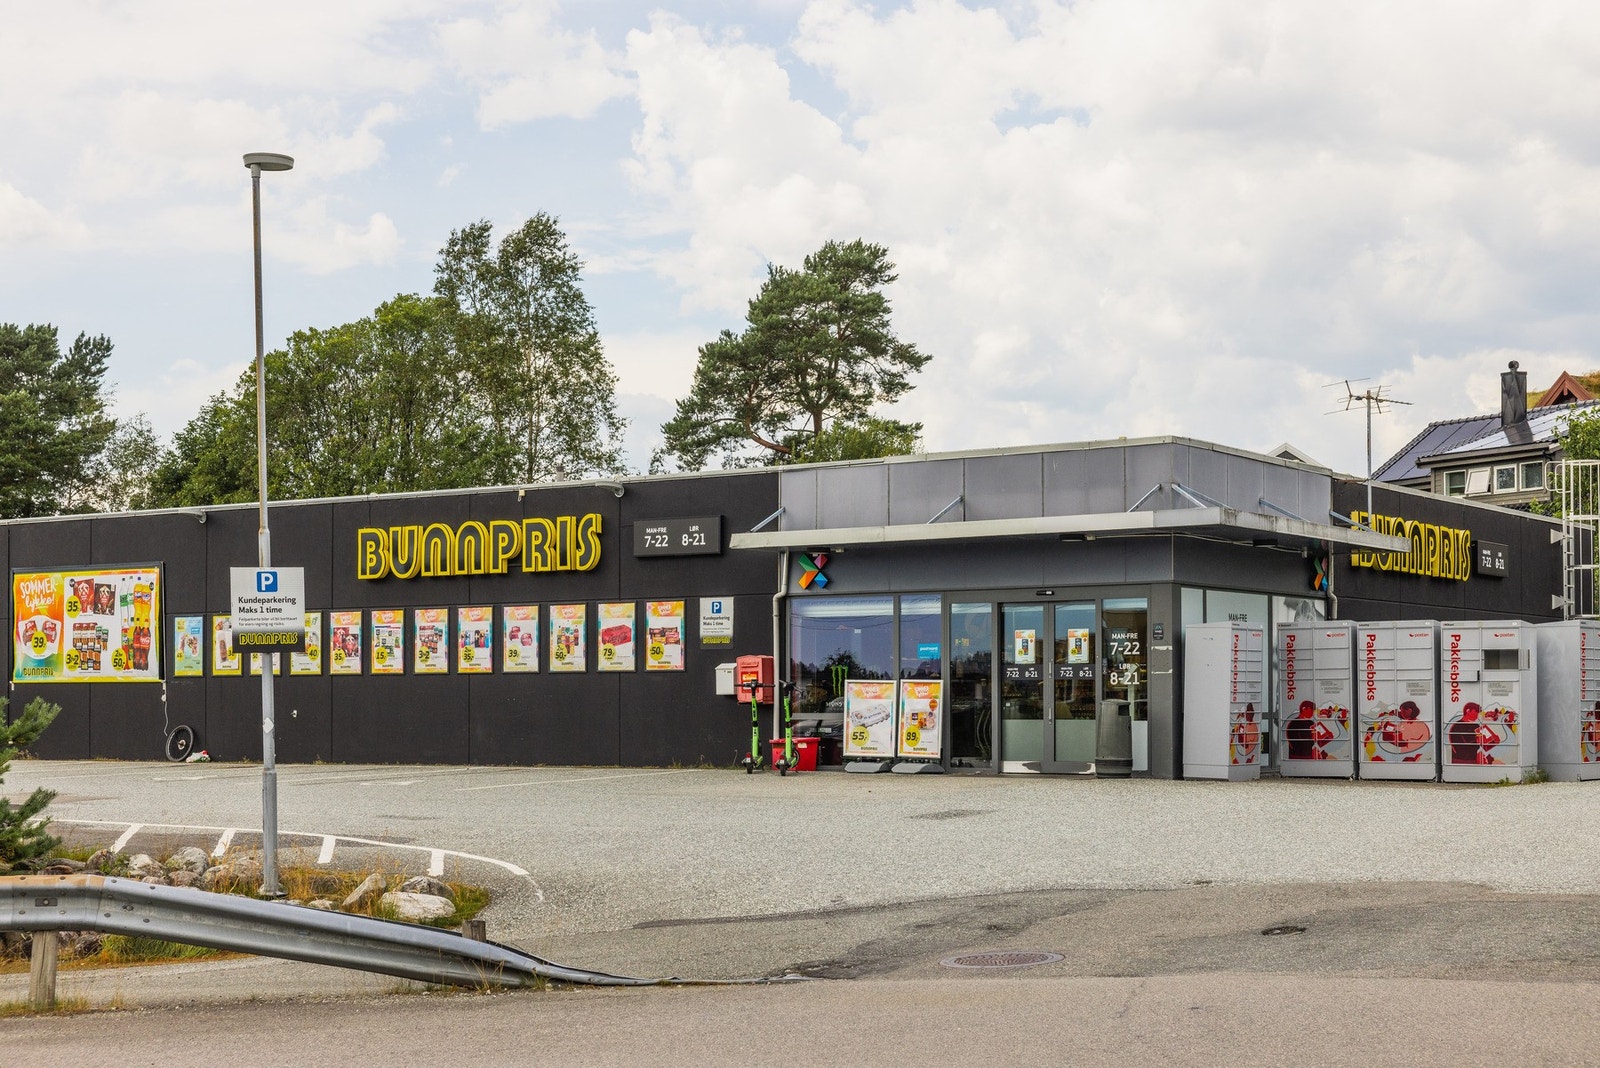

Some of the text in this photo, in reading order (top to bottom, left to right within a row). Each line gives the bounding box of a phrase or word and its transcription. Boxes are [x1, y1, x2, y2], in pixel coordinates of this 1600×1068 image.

[358, 514, 602, 579] BUNNPRIS
[644, 533, 706, 548] 7-22 8-21
[261, 573, 274, 590] P
[238, 597, 296, 605] Kundeparkering
[714, 603, 720, 613] P
[240, 632, 298, 645] BUNNPRIS
[1110, 642, 1140, 655] 7-22
[1286, 635, 1296, 700] Pakkeboks
[1366, 634, 1376, 701] Pakkeboks
[1450, 634, 1461, 703] Pakkeboks
[1110, 672, 1140, 685] 8-21
